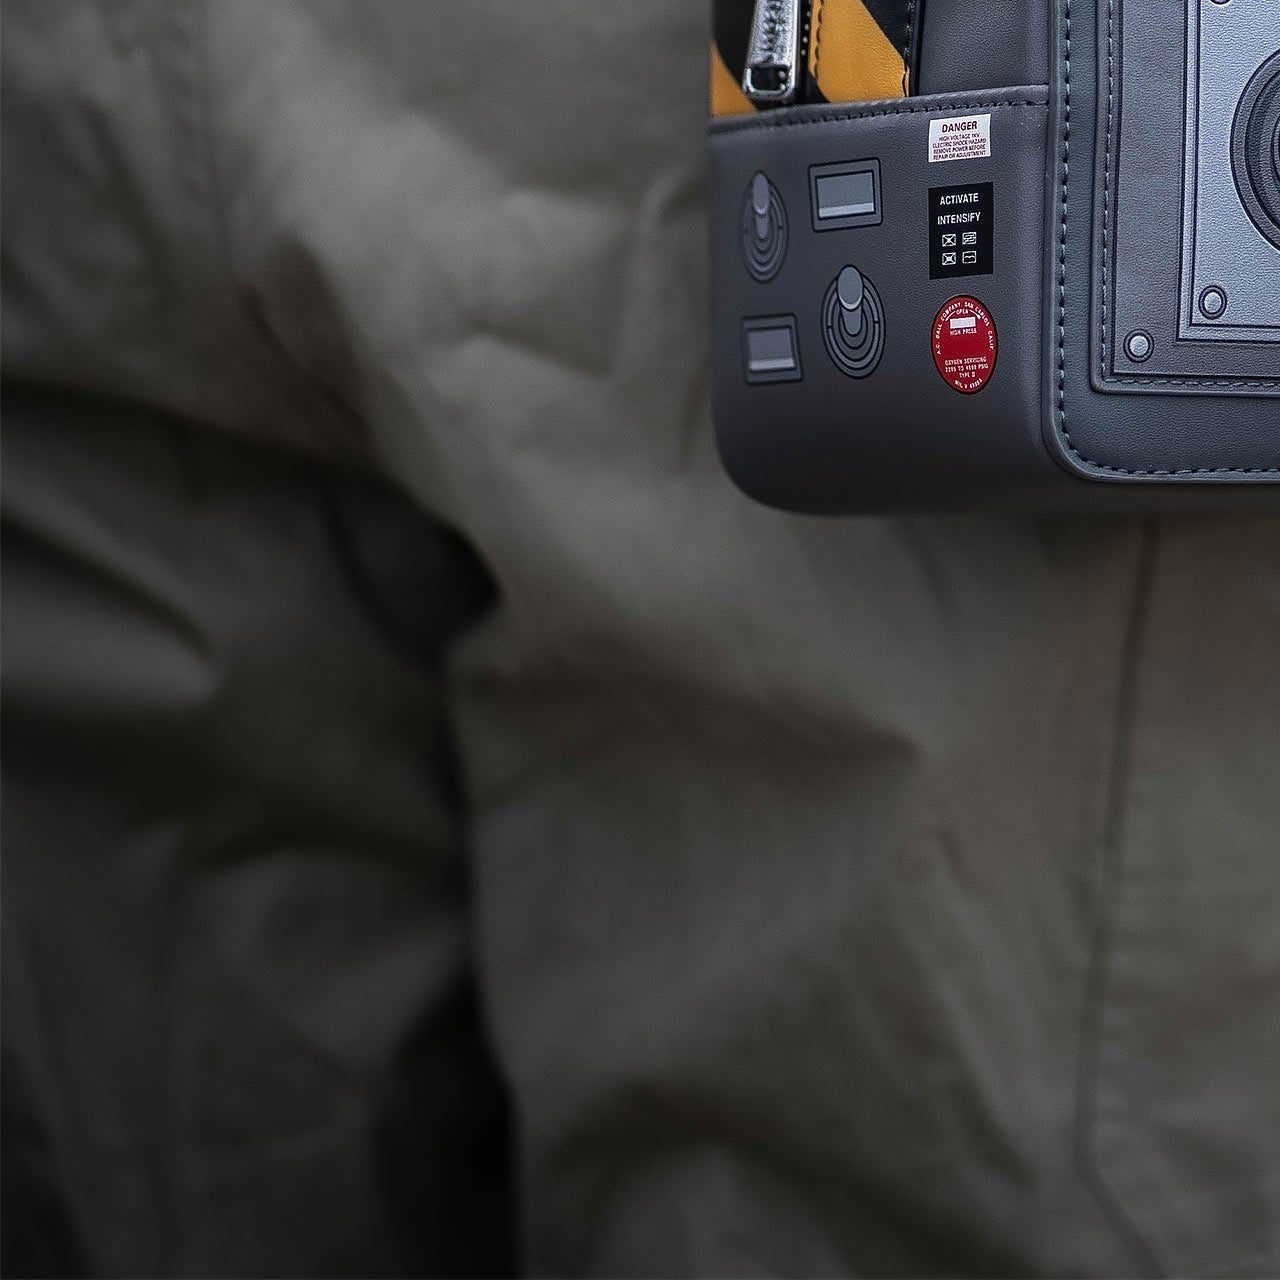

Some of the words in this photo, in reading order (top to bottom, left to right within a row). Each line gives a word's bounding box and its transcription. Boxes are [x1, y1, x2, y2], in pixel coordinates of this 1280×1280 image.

[942, 121, 977, 133] DANGER
[940, 193, 979, 205] ACTIVATE
[937, 212, 981, 225] INTENSIFY
